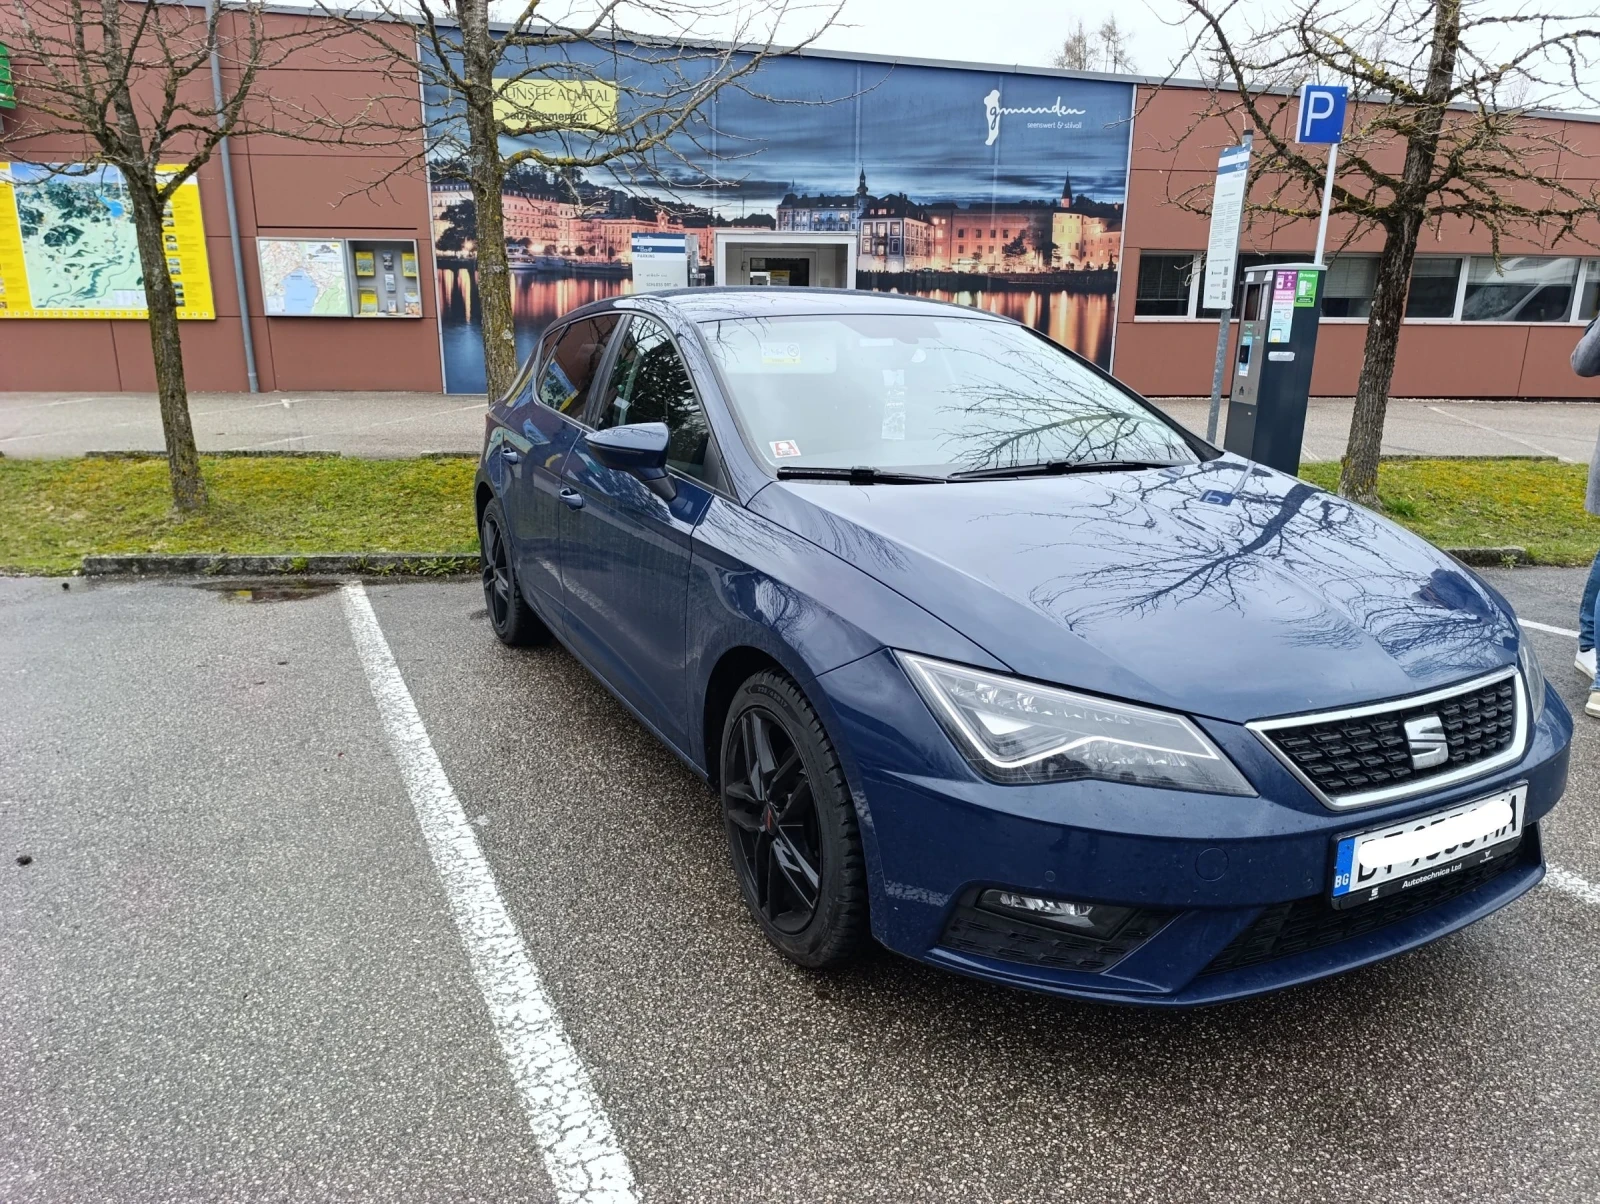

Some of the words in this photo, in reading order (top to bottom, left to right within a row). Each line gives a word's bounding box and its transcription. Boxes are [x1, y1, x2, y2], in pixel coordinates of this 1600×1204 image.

[1304, 91, 1335, 137] P
[1334, 873, 1350, 889] BG
[1402, 868, 1451, 889] Autotechnica
[1451, 862, 1463, 873] Ltd
